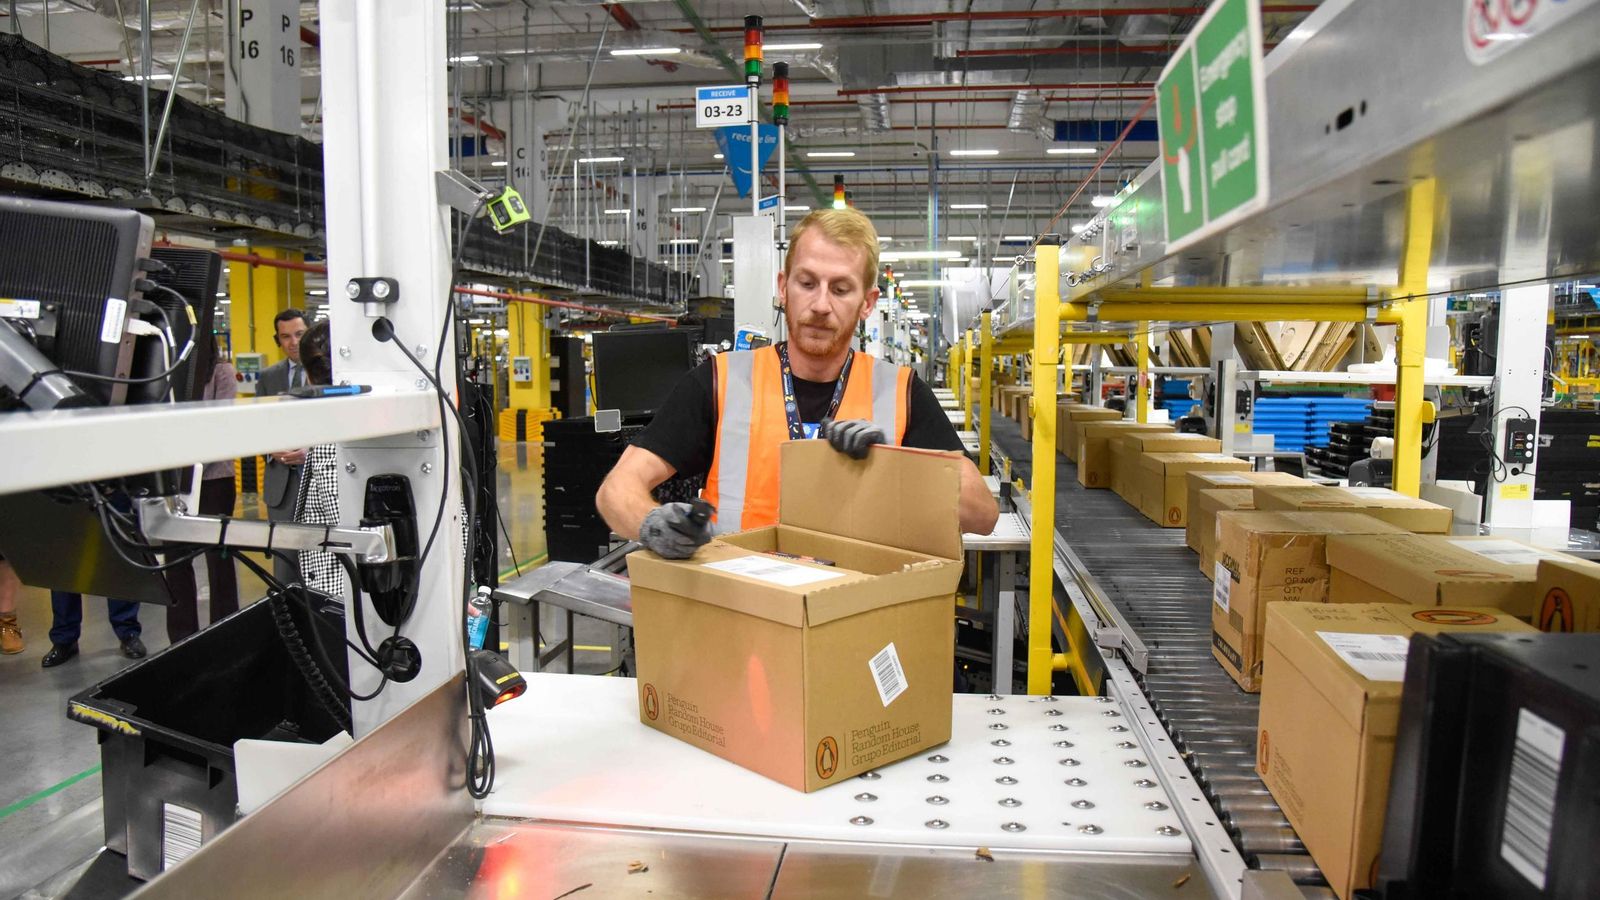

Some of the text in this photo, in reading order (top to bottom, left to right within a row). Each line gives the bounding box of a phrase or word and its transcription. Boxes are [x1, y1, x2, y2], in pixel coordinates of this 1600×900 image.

[241, 9, 253, 28] P
[281, 14, 291, 32] P
[241, 40, 259, 59] 16
[280, 45, 295, 67] 16
[704, 104, 743, 118] 03-23
[637, 208, 645, 217] N
[636, 222, 647, 231] 16
[1285, 567, 1305, 575] REF
[1283, 586, 1304, 594] QTY
[667, 692, 698, 714] Penguin
[668, 703, 724, 735] Random House
[668, 716, 726, 748] Grupo Editorial
[851, 720, 891, 741] Penguin
[852, 723, 920, 754] Random House
[851, 732, 921, 766] Grupo Editorial
